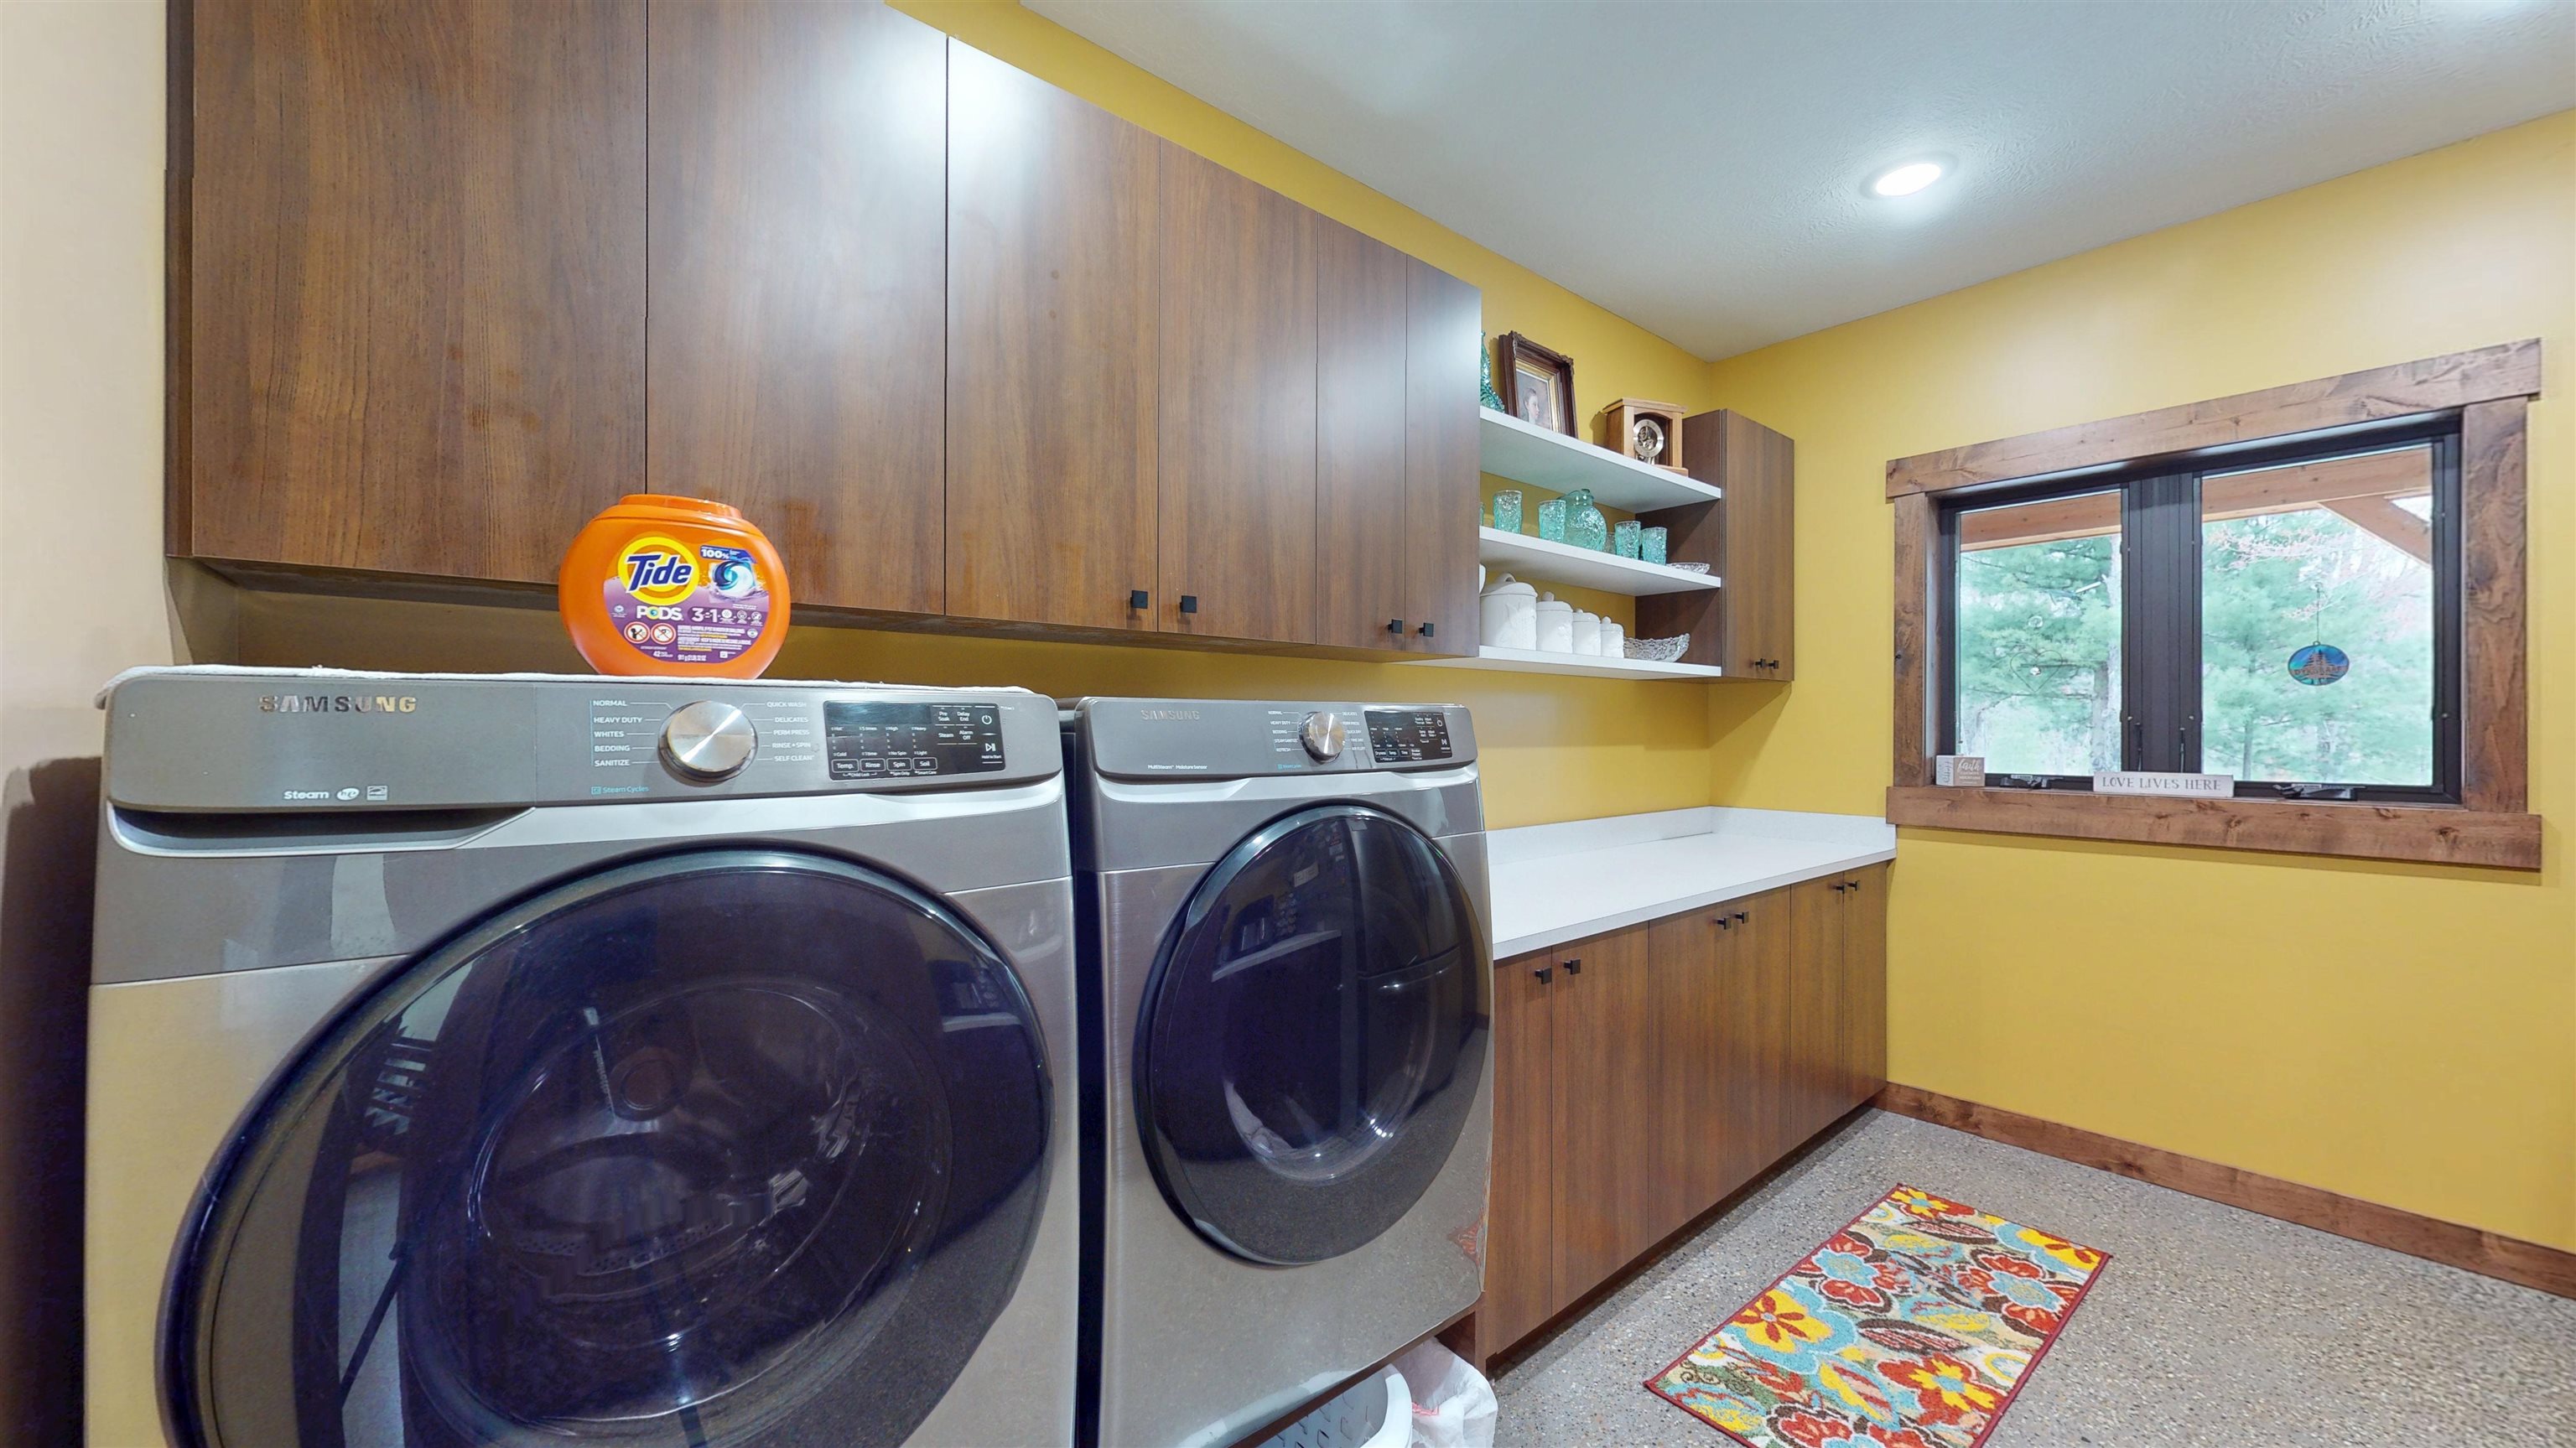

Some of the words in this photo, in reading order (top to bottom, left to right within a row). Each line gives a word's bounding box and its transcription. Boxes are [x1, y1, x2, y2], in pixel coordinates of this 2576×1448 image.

[701, 548, 730, 560] 100%
[626, 554, 693, 592] Tide
[636, 605, 683, 620] PODS
[260, 696, 417, 713] SAMSUNG
[1141, 710, 1200, 720] SAMSUNG
[2102, 776, 2134, 787] LOVE
[2140, 777, 2179, 789] LIVES
[2184, 779, 2221, 791] HERE
